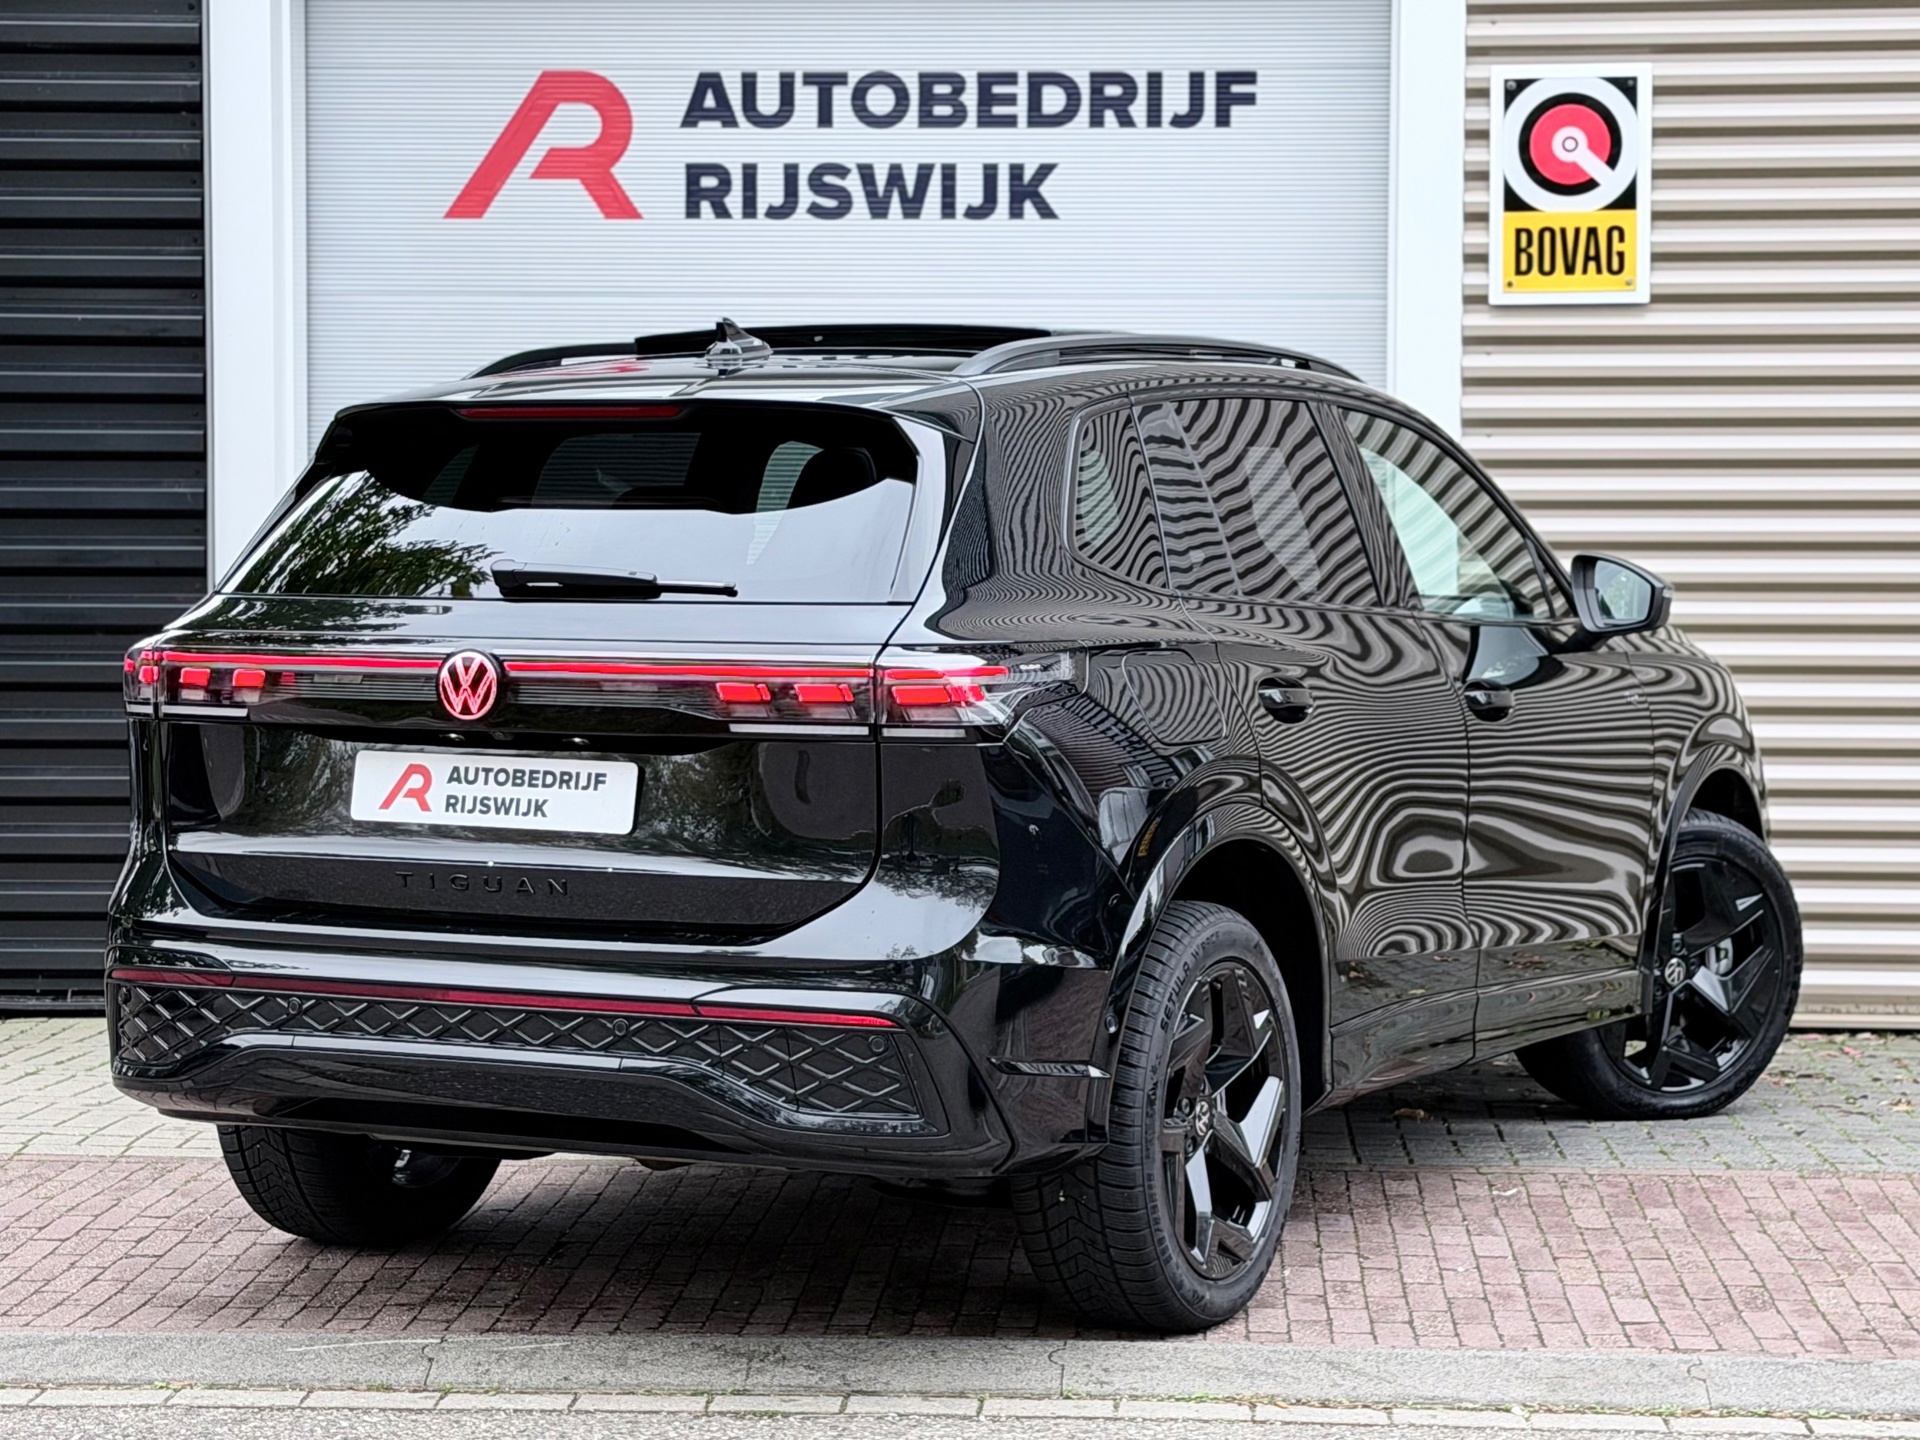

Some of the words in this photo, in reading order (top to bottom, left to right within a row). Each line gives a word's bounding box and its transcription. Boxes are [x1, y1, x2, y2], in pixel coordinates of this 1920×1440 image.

[681, 71, 1258, 129] AUTOBEDRIJF
[685, 162, 1059, 220] RIJSWIJK
[1514, 225, 1626, 277] BOVAG
[446, 765, 607, 792] AUTOBEDRIJF
[445, 794, 548, 818] RIJSWIJK
[394, 871, 568, 895] TIGUAN
